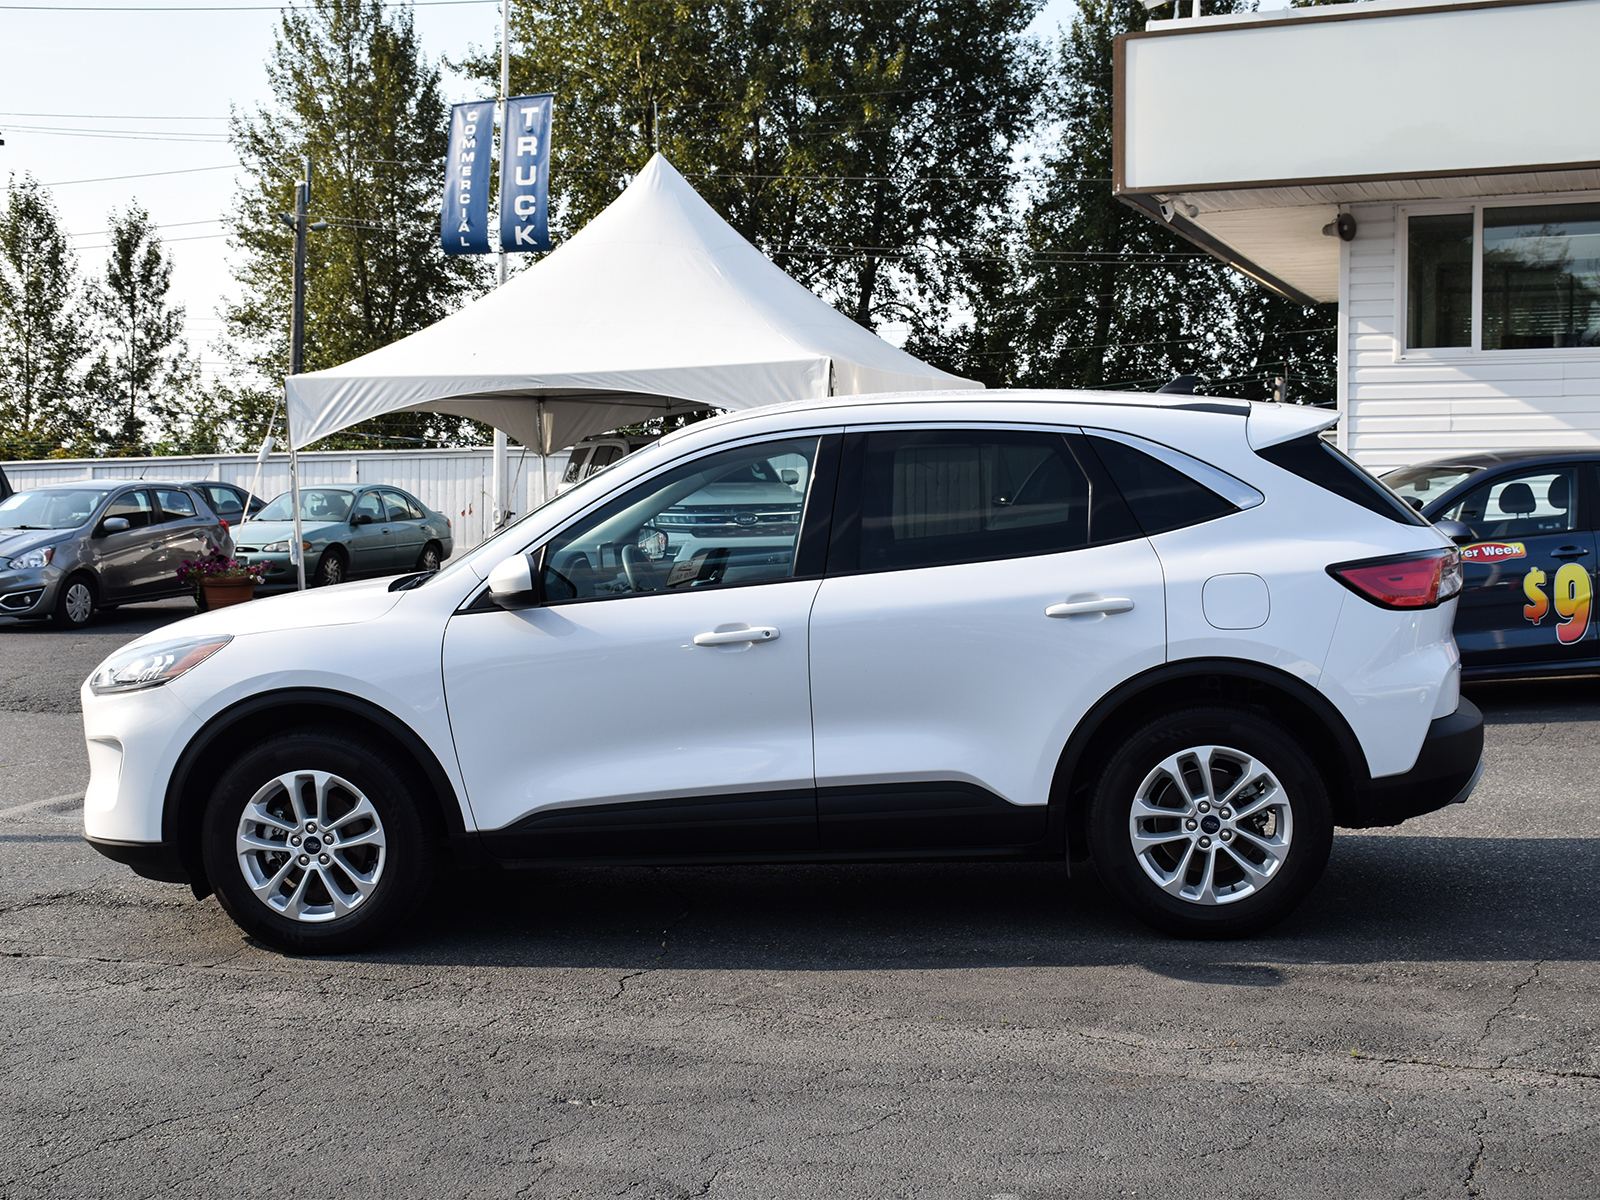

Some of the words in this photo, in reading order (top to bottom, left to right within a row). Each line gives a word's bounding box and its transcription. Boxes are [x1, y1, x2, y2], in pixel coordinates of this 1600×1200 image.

[458, 111, 477, 246] COMMERCIAL
[514, 106, 540, 245] TRUCK
[1481, 544, 1522, 557] Week
